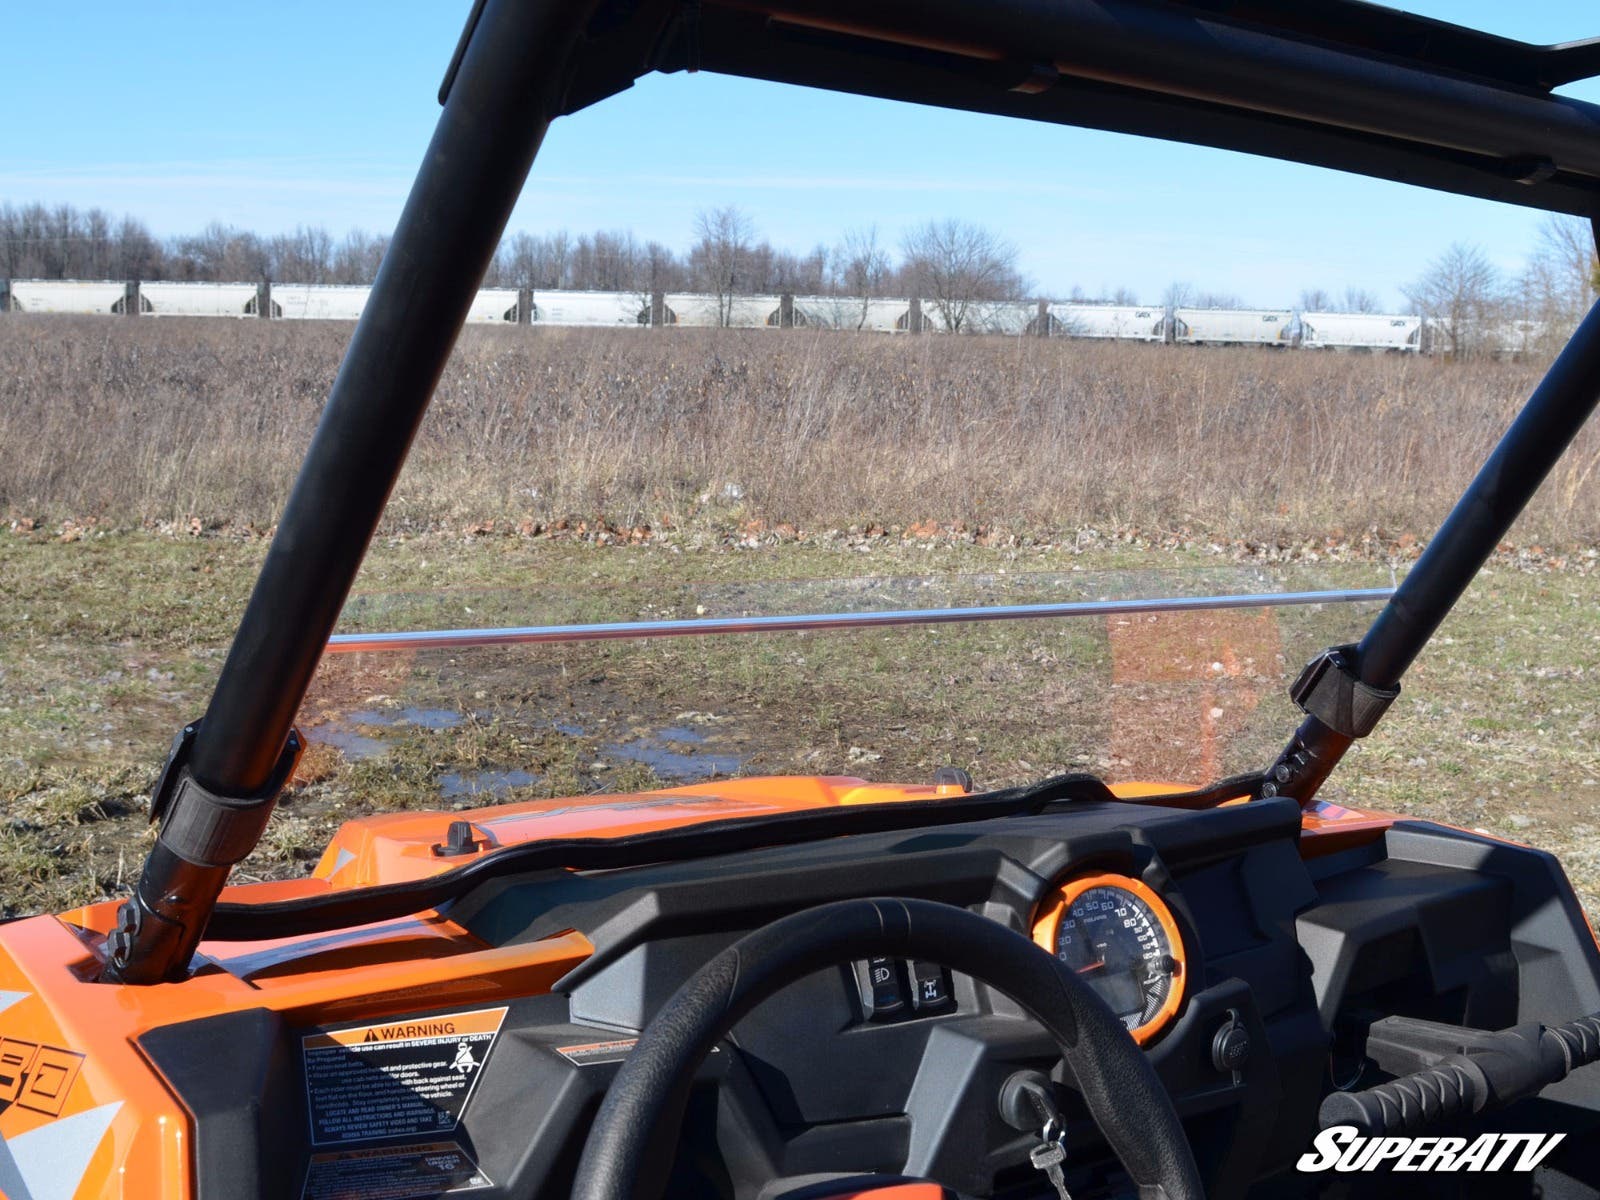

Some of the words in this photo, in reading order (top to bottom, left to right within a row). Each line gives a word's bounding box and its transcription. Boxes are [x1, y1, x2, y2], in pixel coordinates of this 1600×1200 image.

[1086, 901, 1099, 911] 50
[1101, 901, 1114, 911] 60
[1072, 908, 1084, 917] 40
[1114, 907, 1127, 917] 70
[1062, 920, 1076, 930] 30
[1123, 918, 1137, 928] 80
[1059, 935, 1072, 945] 20
[381, 1022, 455, 1040] WARNING
[411, 1039, 437, 1047] SEVERE
[438, 1037, 461, 1045] INJURY
[469, 1034, 492, 1042] DEATH
[402, 1061, 432, 1071] protective
[413, 1077, 429, 1085] back
[429, 1075, 451, 1083] against
[415, 1084, 440, 1092] steering
